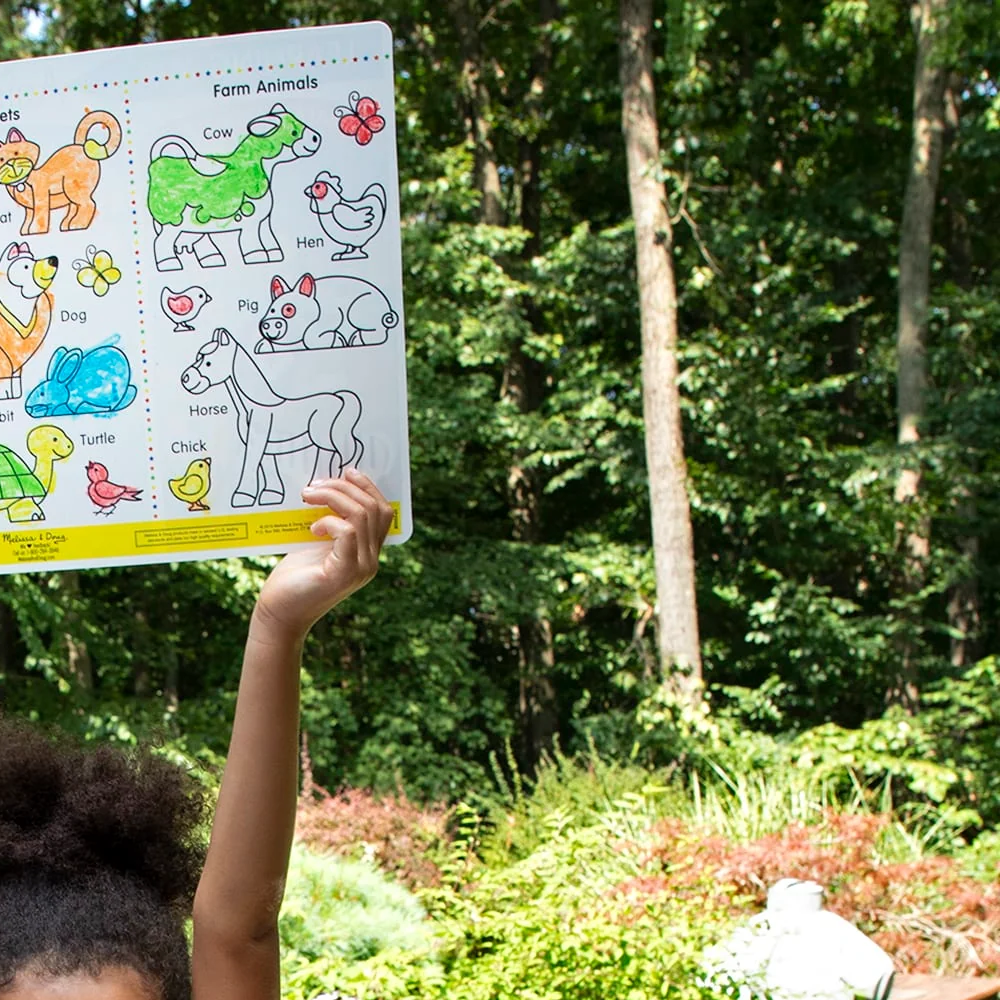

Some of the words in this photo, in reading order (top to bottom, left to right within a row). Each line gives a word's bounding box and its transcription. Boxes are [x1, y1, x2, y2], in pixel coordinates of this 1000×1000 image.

[213, 82, 251, 98] Farm
[256, 75, 318, 94] Animals
[203, 126, 233, 140] Cow
[296, 235, 324, 250] Hen
[238, 299, 259, 314] Pig
[61, 308, 87, 324] Dog
[189, 403, 228, 418] Horse
[80, 432, 116, 446] Turtle
[171, 440, 207, 454] Chick
[2, 530, 37, 543] Melissa
